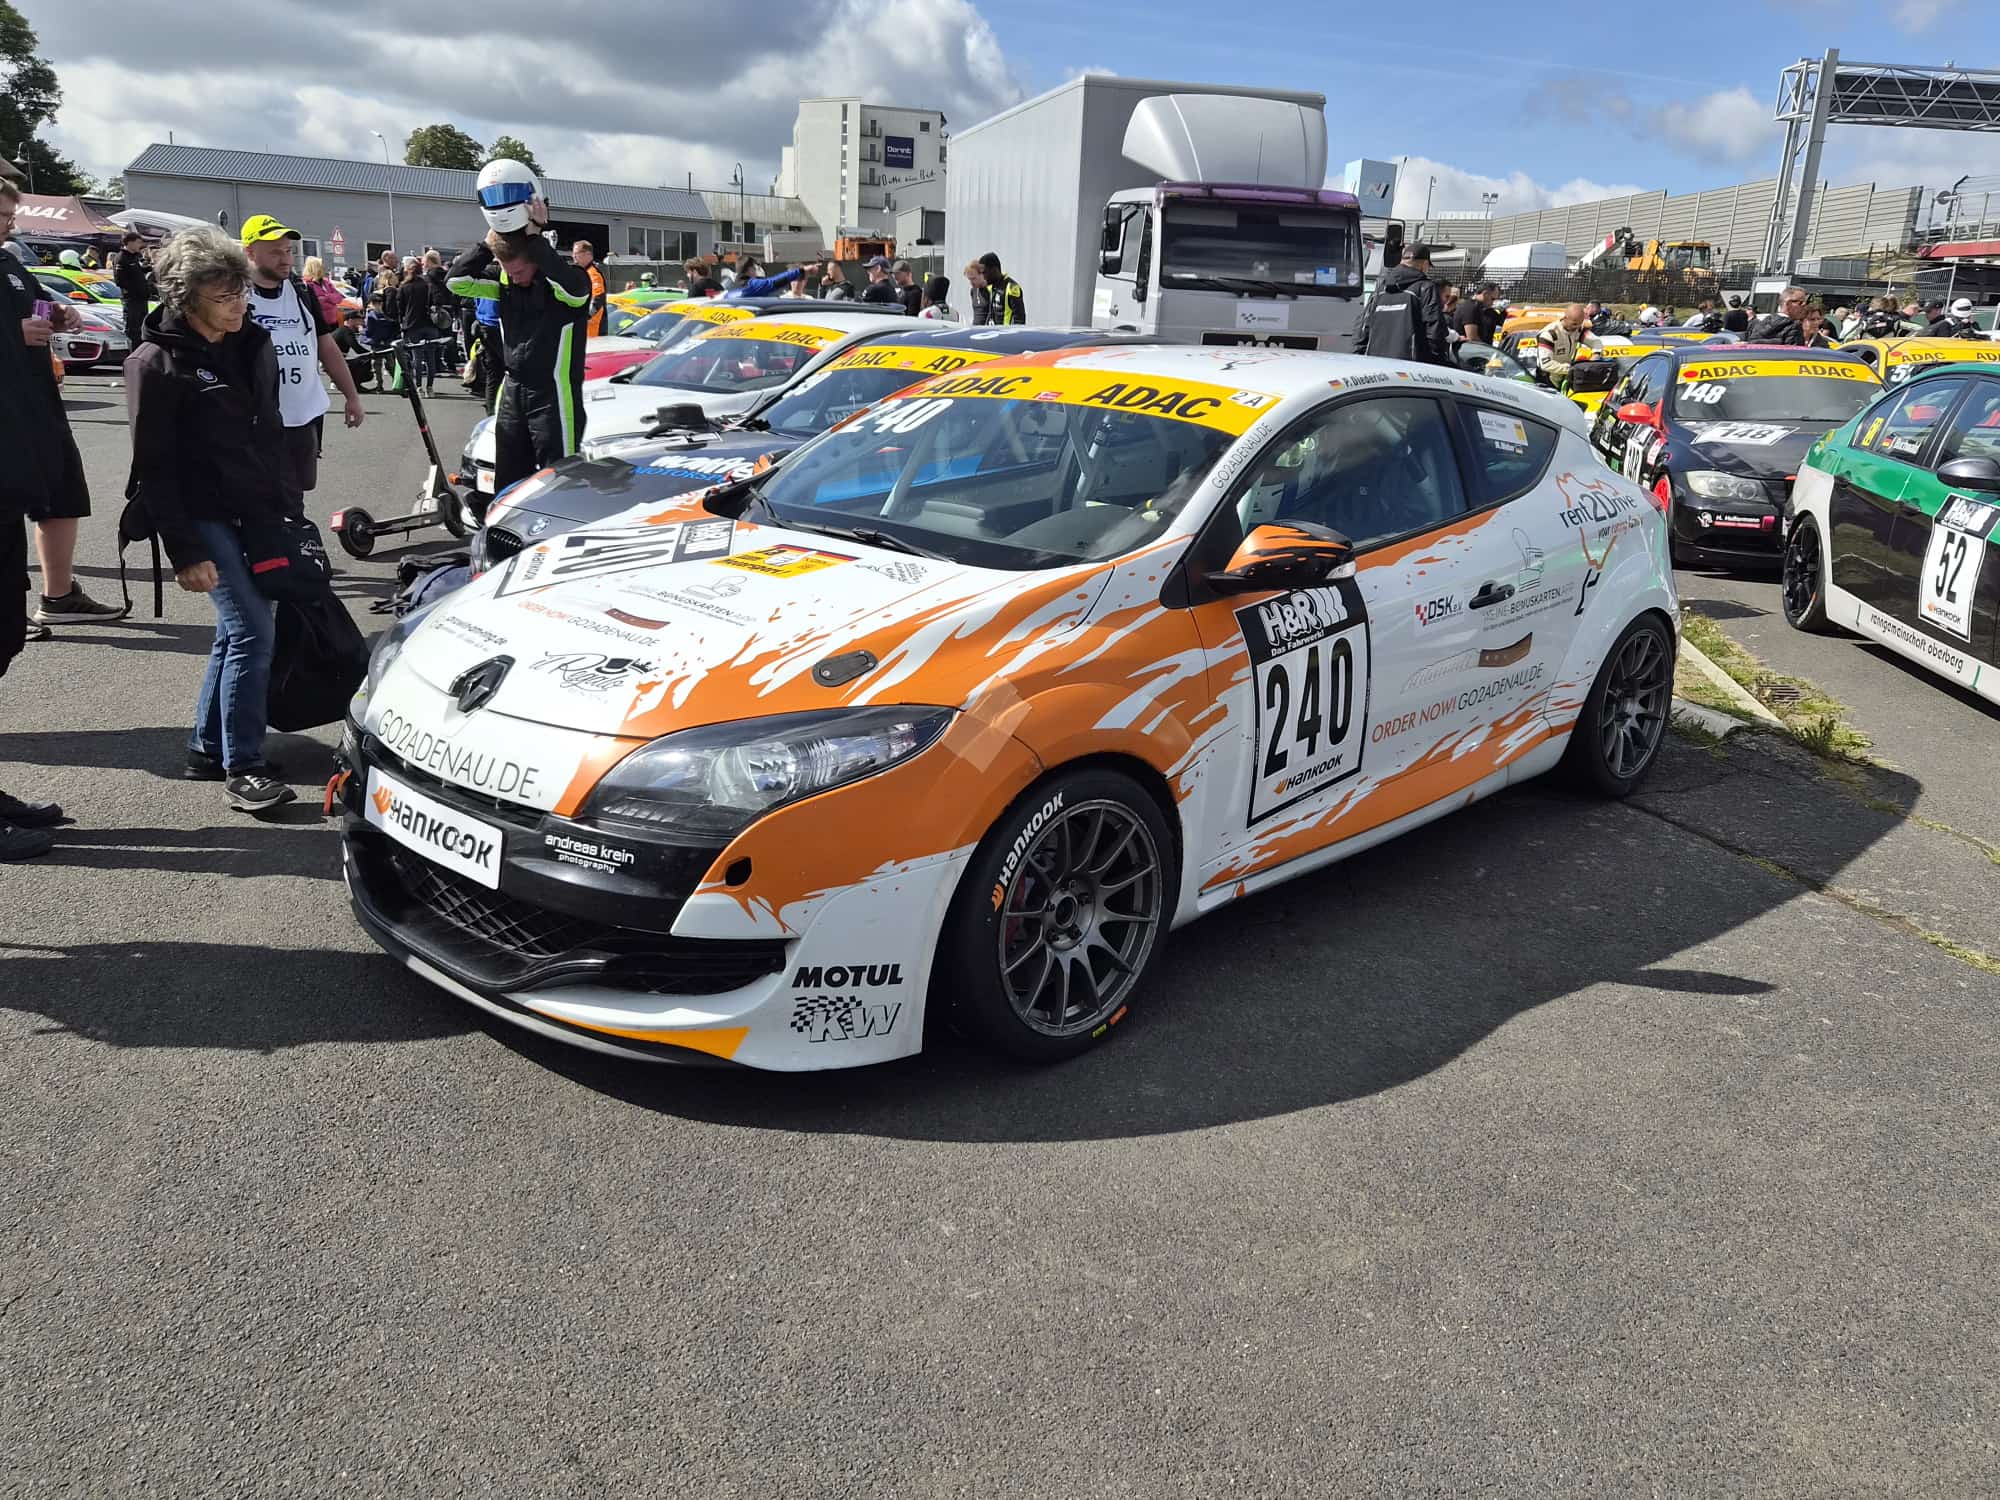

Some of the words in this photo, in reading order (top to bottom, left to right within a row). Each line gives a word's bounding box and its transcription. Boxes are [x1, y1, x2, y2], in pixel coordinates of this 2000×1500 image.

[274, 341, 310, 356] edia
[773, 331, 823, 346] ADAC
[834, 351, 896, 368] ADAC
[1601, 348, 1630, 357] DAC
[1902, 352, 1946, 363] ADAC
[1976, 352, 2000, 361] AD
[1699, 365, 1758, 378] ADAC
[1798, 364, 1857, 378] ADAC
[924, 376, 1032, 397] ADAC
[1681, 382, 1727, 405] 148
[1083, 383, 1222, 419] ADAC
[838, 399, 954, 434] 240
[1719, 428, 1778, 440] 148
[1212, 422, 1273, 490] GO2ADENAU.DE
[551, 527, 677, 575] 240
[1935, 531, 1968, 604] 52
[1259, 589, 1332, 647] H&R
[1428, 594, 1454, 620] DSK
[1870, 612, 1927, 651] renngemeinschaft
[1927, 641, 1964, 674] oberberg
[1263, 637, 1354, 779] 240
[1371, 711, 1416, 744] ORDER
[1419, 696, 1457, 726] NOW!
[1458, 662, 1544, 711] GO2ADENAU.DE
[377, 708, 540, 799] GO2ADENAU.DE
[545, 834, 598, 856] andreas
[600, 845, 635, 865] krein
[558, 854, 615, 874] photography
[792, 964, 904, 988] MOTUL
[809, 1001, 902, 1043] KW
